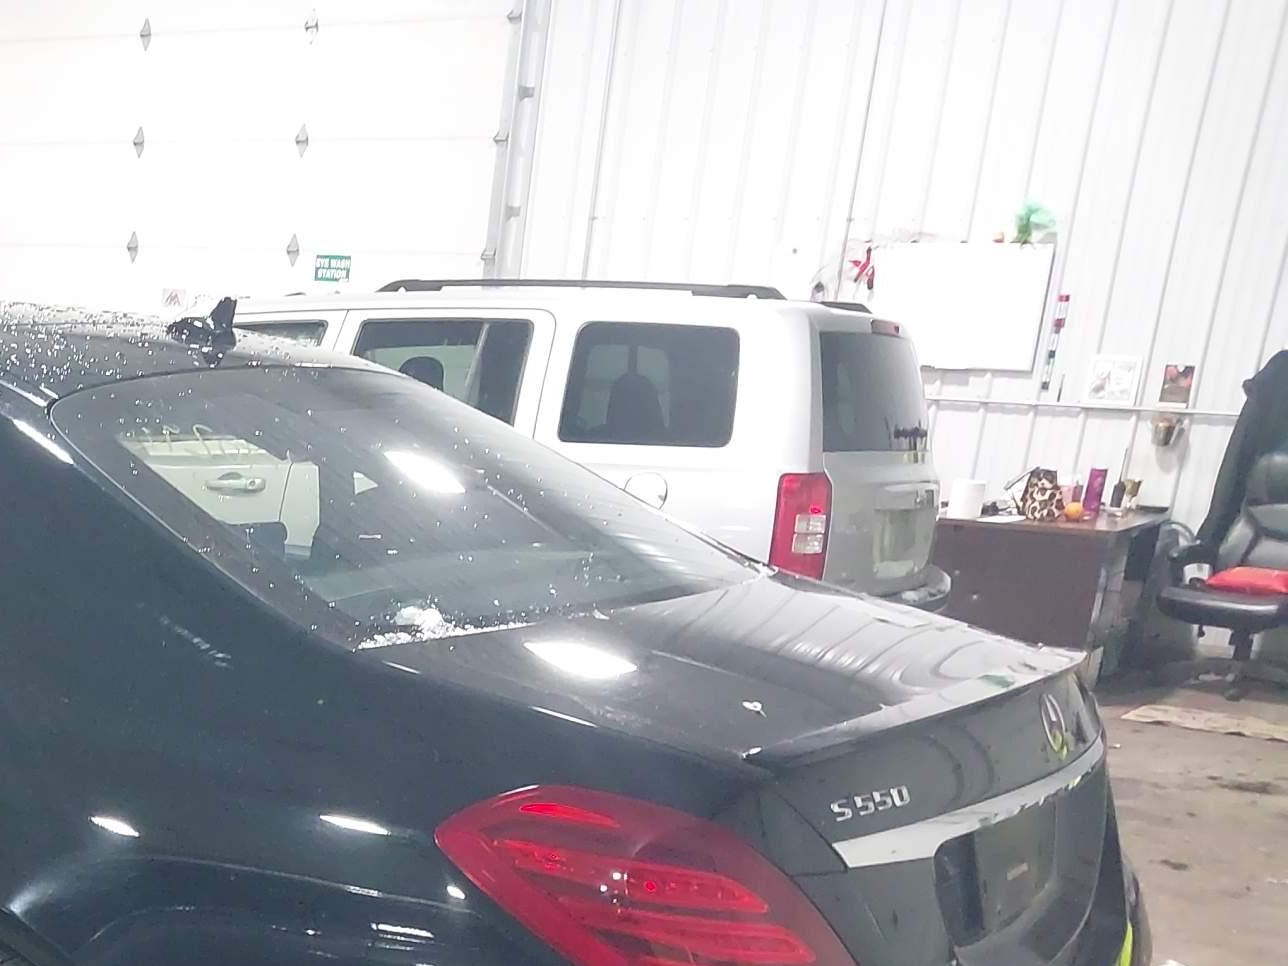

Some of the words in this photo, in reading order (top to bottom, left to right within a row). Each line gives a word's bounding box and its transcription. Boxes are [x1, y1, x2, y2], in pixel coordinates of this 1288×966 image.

[316, 258, 329, 268] EYE
[330, 258, 351, 270] WASH
[317, 268, 347, 279] STATION
